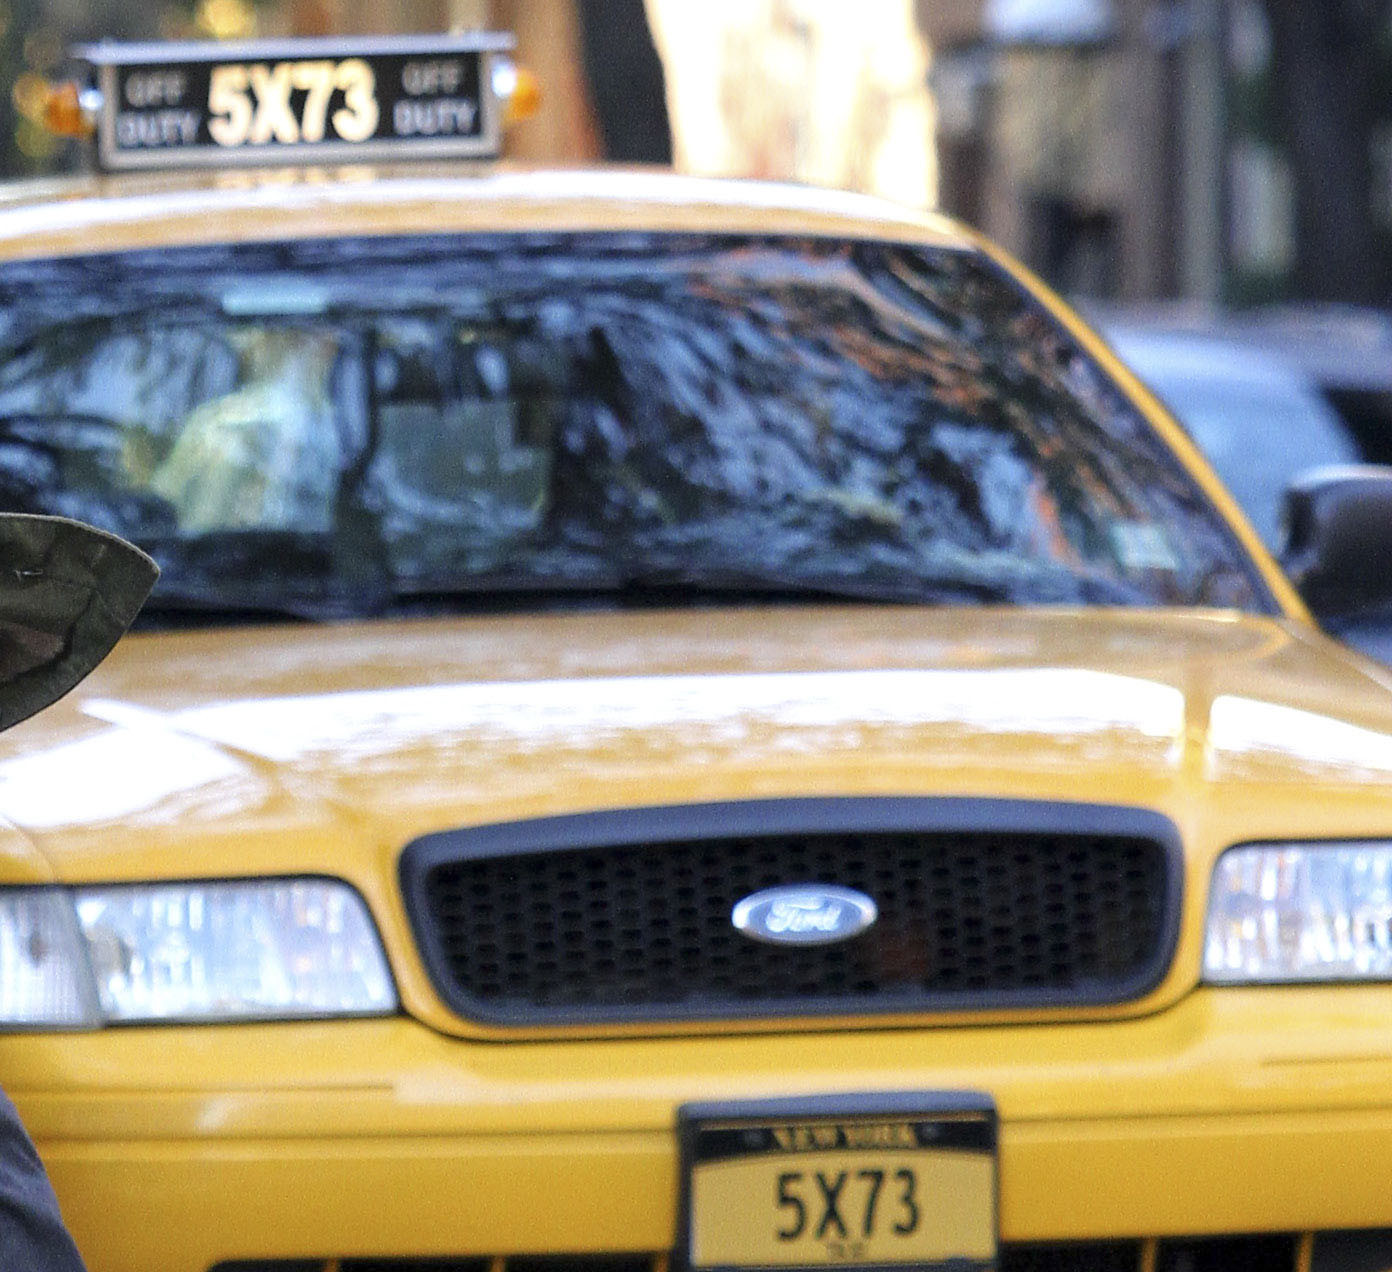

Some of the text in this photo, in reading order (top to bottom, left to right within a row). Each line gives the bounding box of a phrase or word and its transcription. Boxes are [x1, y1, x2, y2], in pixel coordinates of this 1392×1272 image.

[208, 59, 380, 147] 5X73
[392, 99, 477, 135] DUTY
[775, 1168, 921, 1241] 5X73
